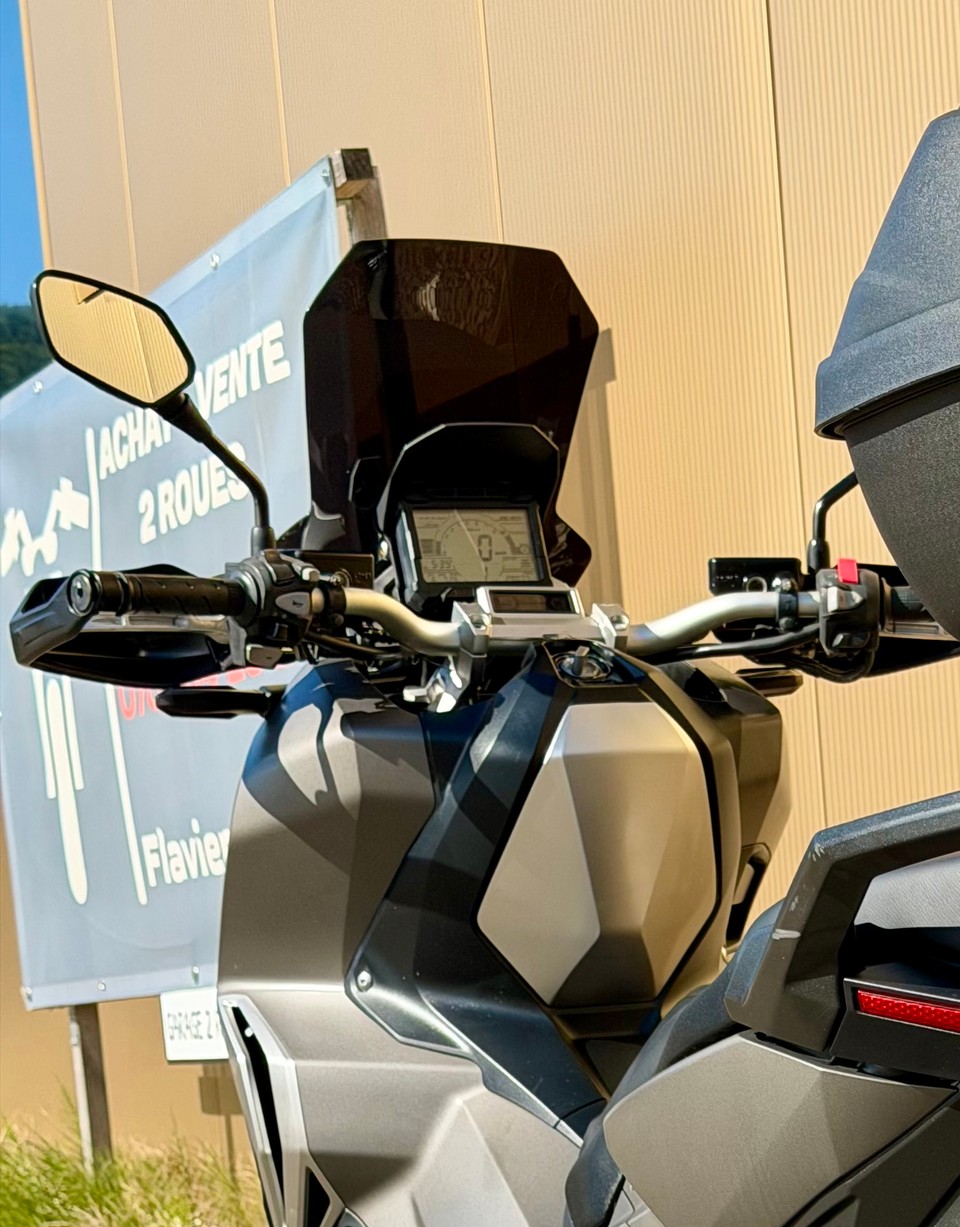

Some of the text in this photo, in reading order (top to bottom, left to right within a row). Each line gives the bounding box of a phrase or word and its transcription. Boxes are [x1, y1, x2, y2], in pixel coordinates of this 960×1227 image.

[195, 320, 291, 421] VENTE
[138, 441, 249, 544] 2 ROUES
